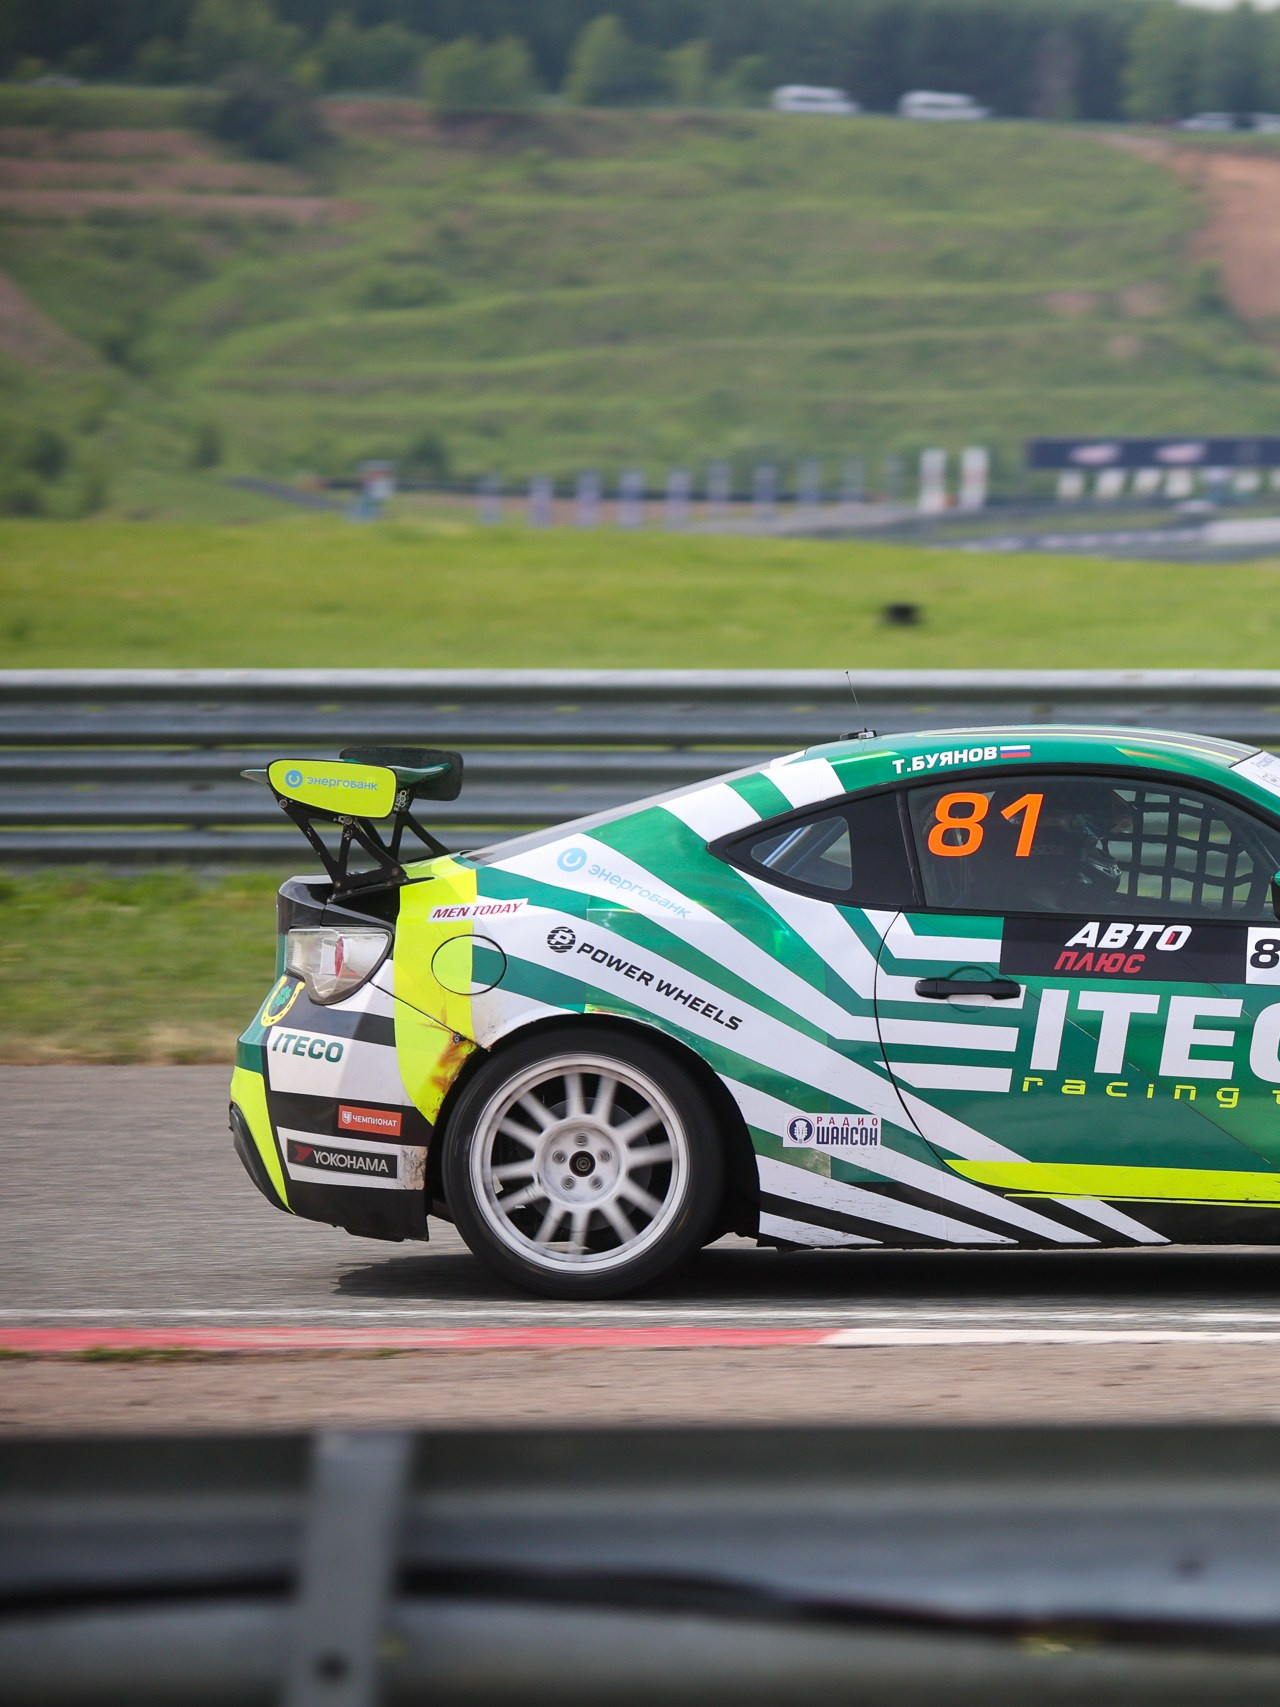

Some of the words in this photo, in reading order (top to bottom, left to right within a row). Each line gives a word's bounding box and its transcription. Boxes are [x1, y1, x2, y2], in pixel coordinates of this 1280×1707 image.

[891, 746, 997, 774] Т.БУЯНОВ
[306, 775, 378, 791] энергобанк
[927, 792, 1044, 857] 81
[587, 864, 693, 919] энергобанк
[432, 906, 470, 919] MEN
[471, 902, 524, 916] TODAY
[1064, 921, 1193, 951] АВТО
[1054, 950, 1146, 974] ПЛЮС
[576, 942, 655, 987] POWER
[655, 979, 744, 1032] WHEELS
[271, 1032, 344, 1063] ITECO
[1022, 1076, 1240, 1109] racing
[352, 1114, 397, 1127] ЧЕМПИОНАТ
[816, 1116, 879, 1127] РАДИО
[816, 1126, 878, 1146] ШАНСОН
[312, 1150, 389, 1173] YOKOHAMA
